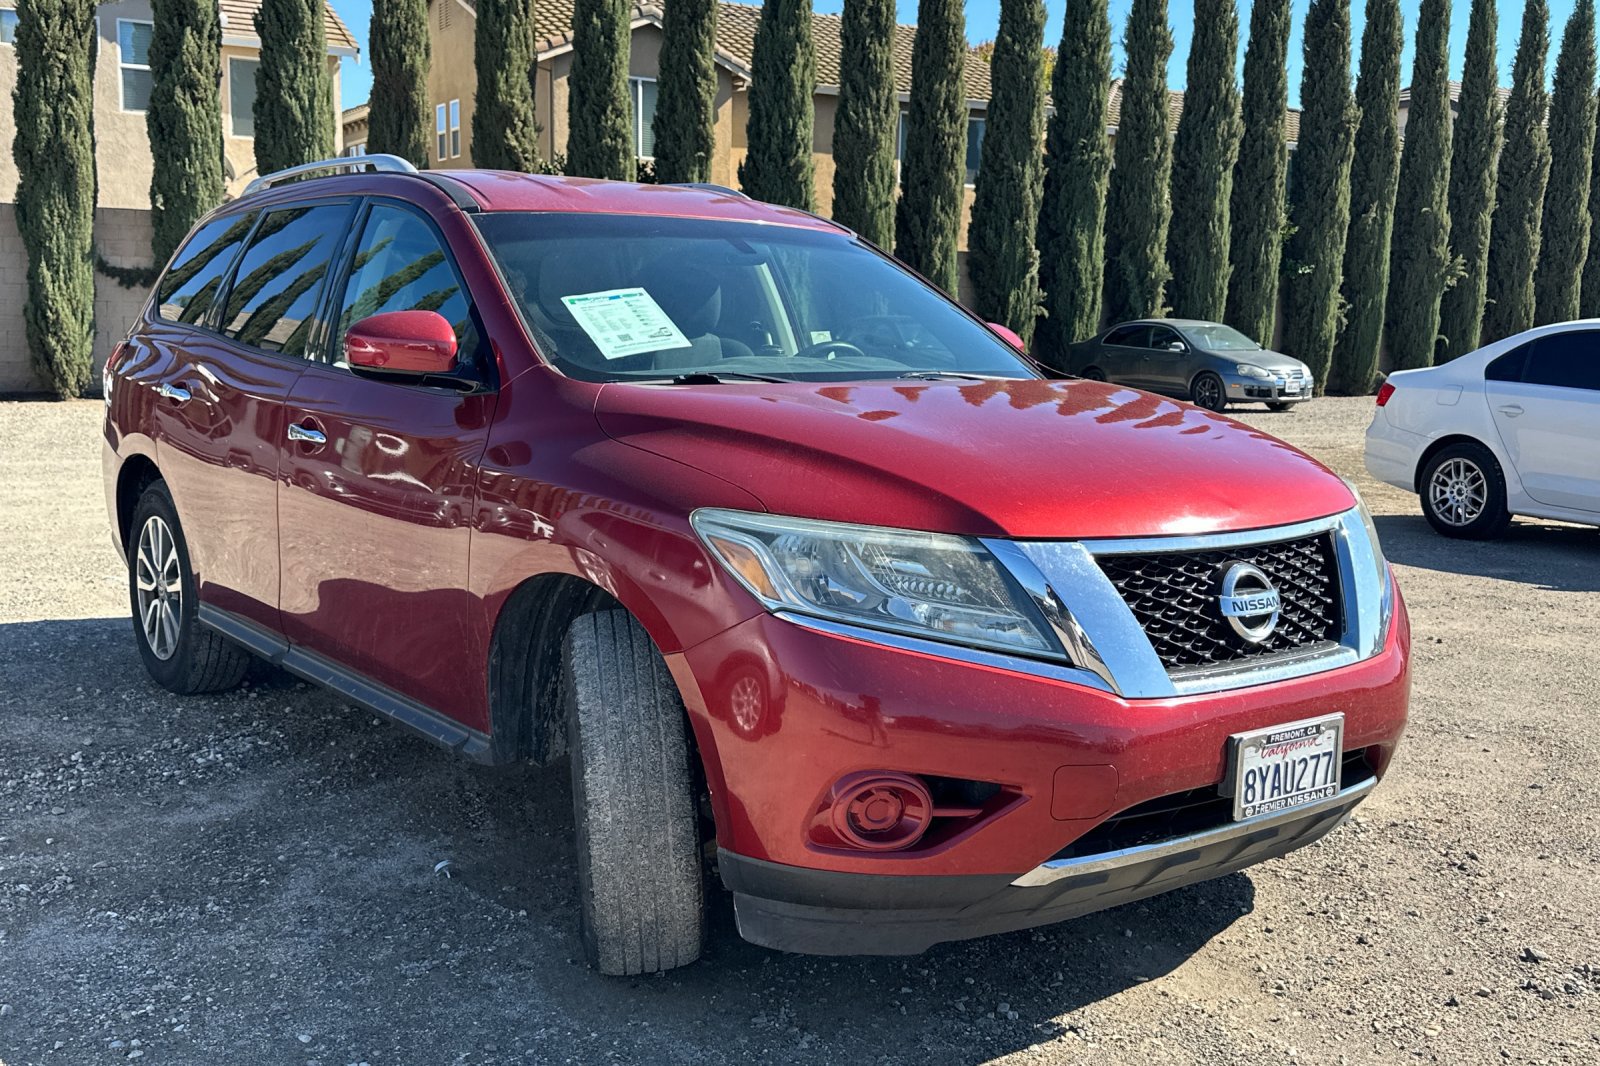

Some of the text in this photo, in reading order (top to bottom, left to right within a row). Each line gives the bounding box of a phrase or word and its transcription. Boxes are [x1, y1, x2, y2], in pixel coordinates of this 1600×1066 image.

[1231, 596, 1279, 612] NISSAN
[1307, 726, 1316, 735] CA
[1261, 737, 1322, 760] California
[1245, 751, 1333, 803] 8YAU277
[1287, 789, 1325, 806] NISSAN
